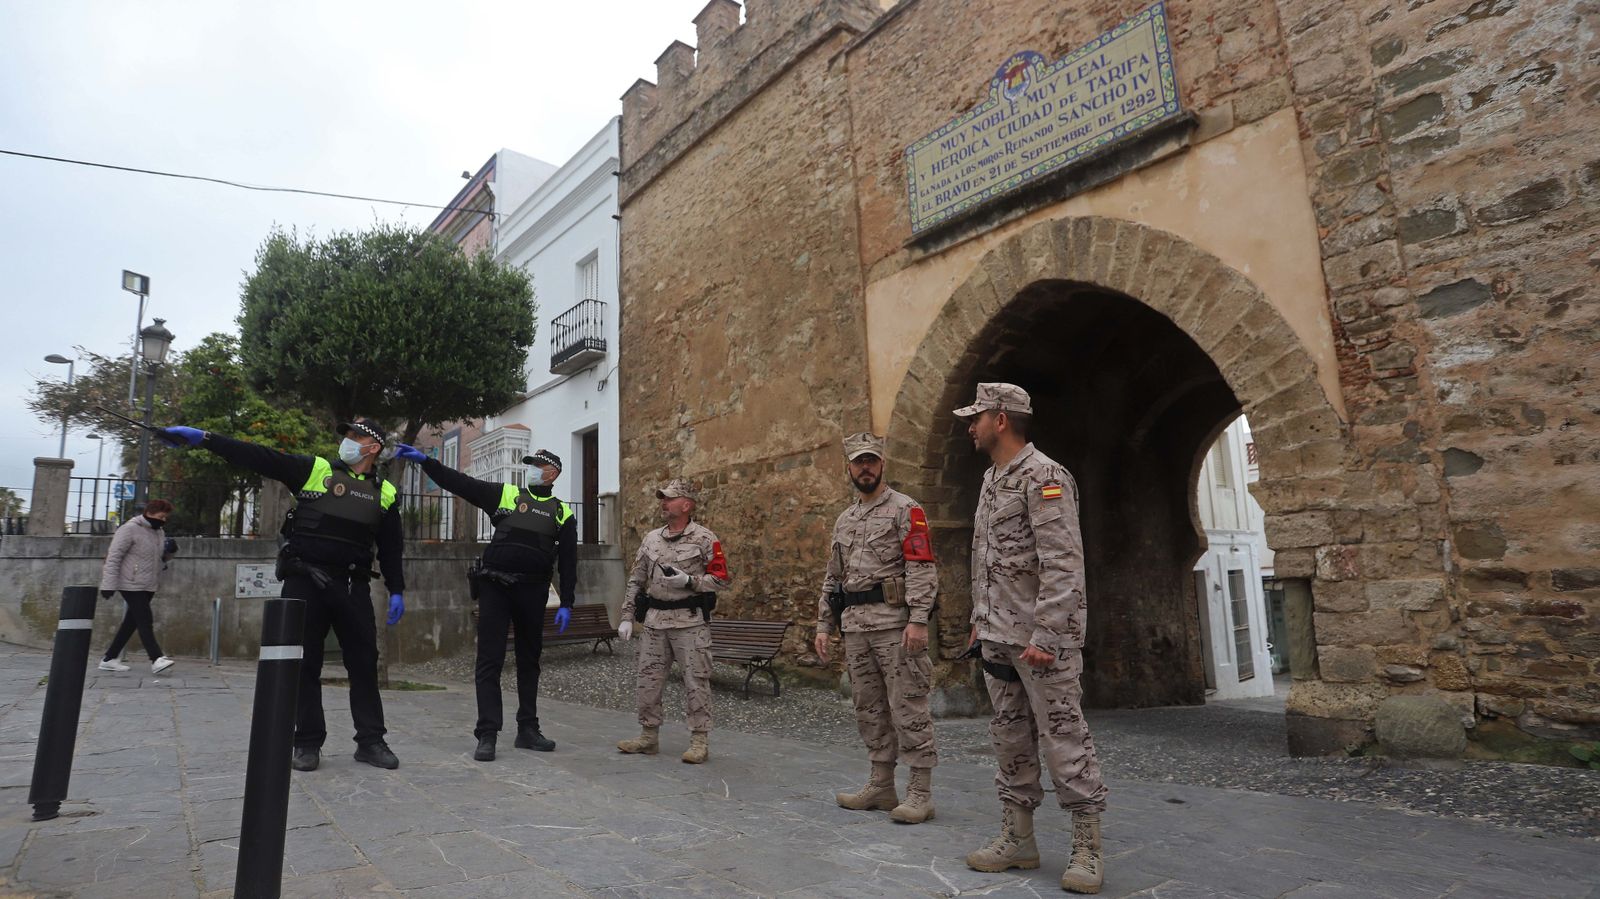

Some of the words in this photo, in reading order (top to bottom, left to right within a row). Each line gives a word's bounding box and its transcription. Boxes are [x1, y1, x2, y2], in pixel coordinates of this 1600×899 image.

[920, 172, 927, 181] Y
[931, 139, 990, 176] HEROICA
[998, 103, 1053, 139] CIUDAD
[1060, 92, 1078, 108] DE
[1086, 54, 1149, 93] TARIFA
[920, 178, 952, 198] GANADA
[954, 173, 959, 181] A
[961, 164, 977, 177] LOS
[978, 150, 1004, 168] MOROS
[1005, 124, 1053, 155] REINANDO
[1058, 83, 1127, 127] SANCHO
[1132, 67, 1152, 90] IV
[922, 203, 933, 213] EL
[935, 180, 971, 206] BRAVO
[973, 176, 986, 188] EN
[989, 165, 1002, 180] 21
[1004, 160, 1018, 173] DE
[1021, 123, 1092, 163] SEPTIEMBRE
[1098, 112, 1116, 127] DE
[1120, 88, 1157, 115] 1292
[940, 131, 968, 153] MUY
[972, 101, 1020, 136] NOBLE
[1025, 78, 1060, 106] MUY
[1065, 54, 1112, 86] LEAL
